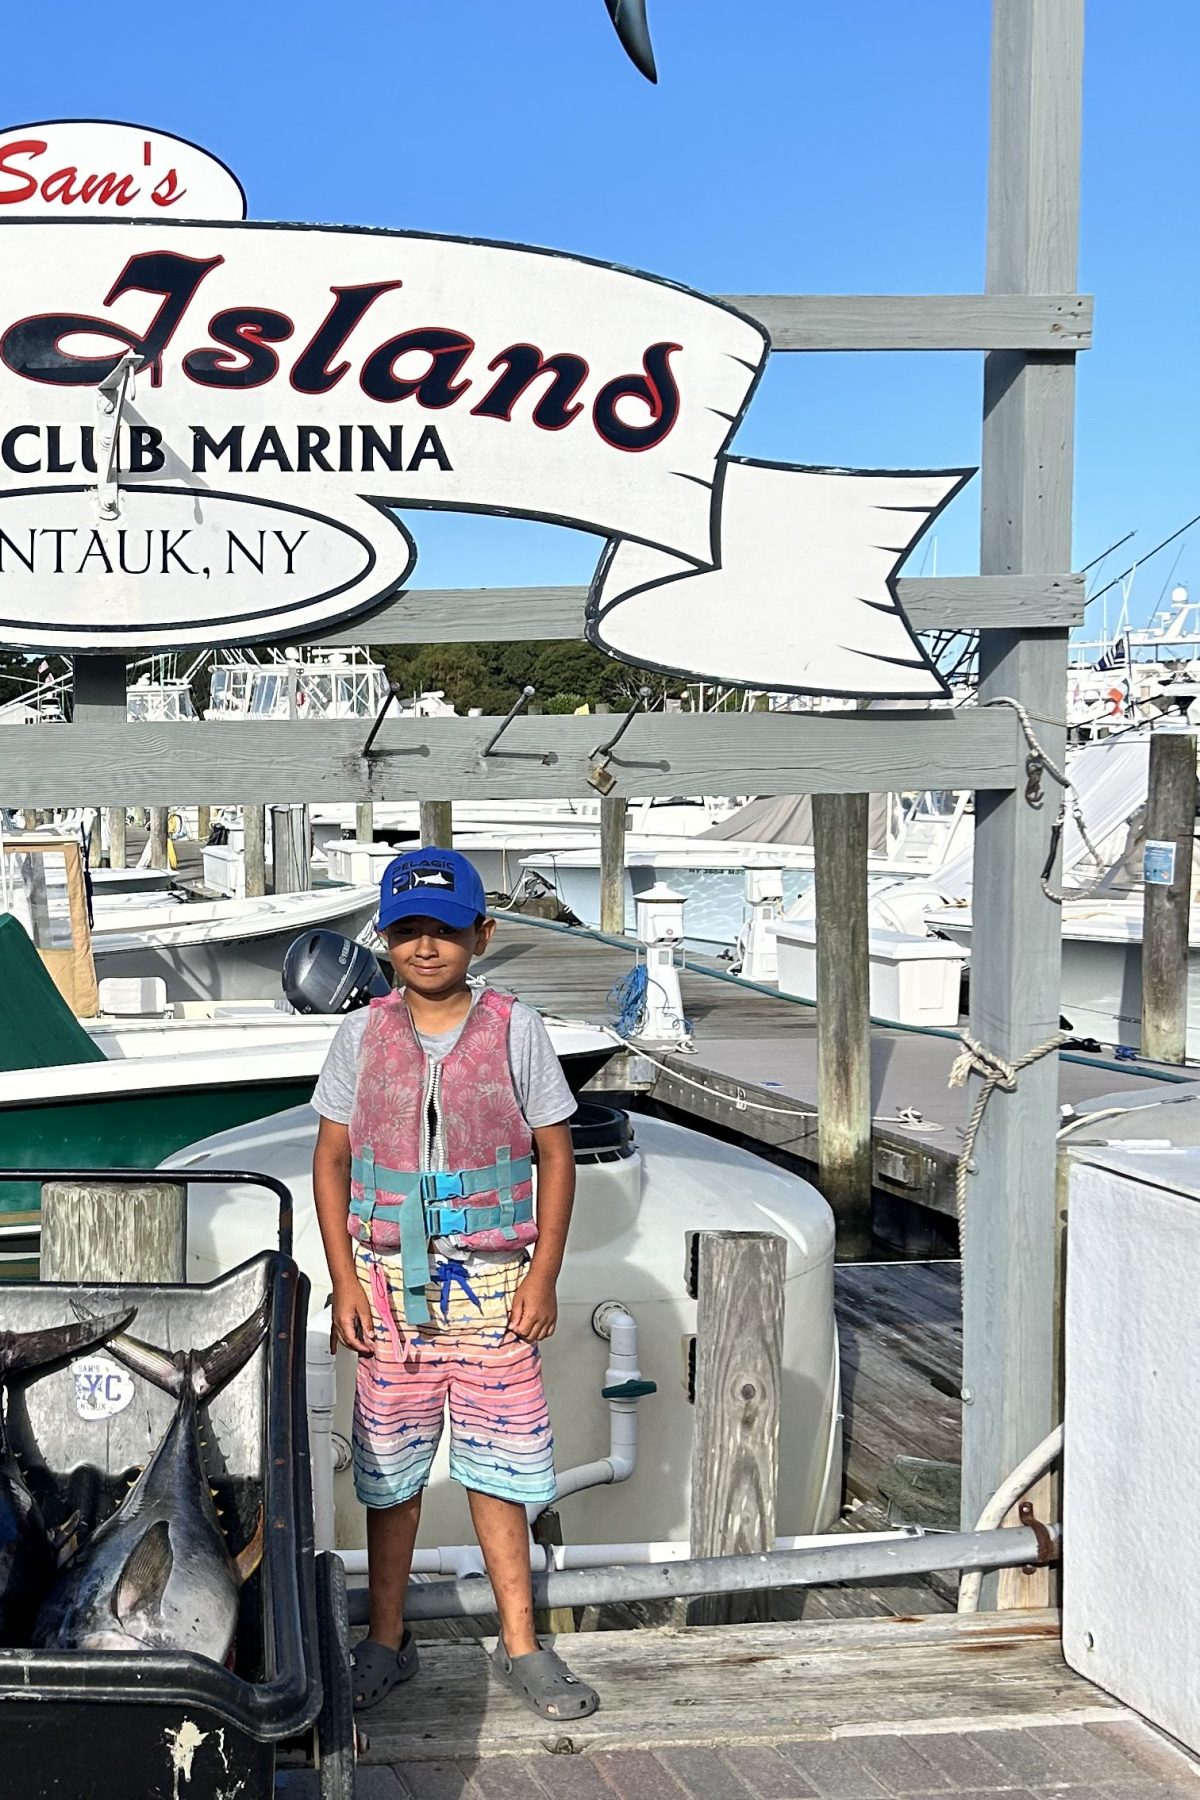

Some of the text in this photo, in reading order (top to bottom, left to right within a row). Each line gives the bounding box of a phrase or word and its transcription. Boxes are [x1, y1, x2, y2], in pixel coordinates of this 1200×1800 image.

[0, 250, 684, 453] Island
[188, 424, 454, 474] MARINA
[224, 529, 310, 575] NY
[392, 860, 455, 875] PELAGIC
